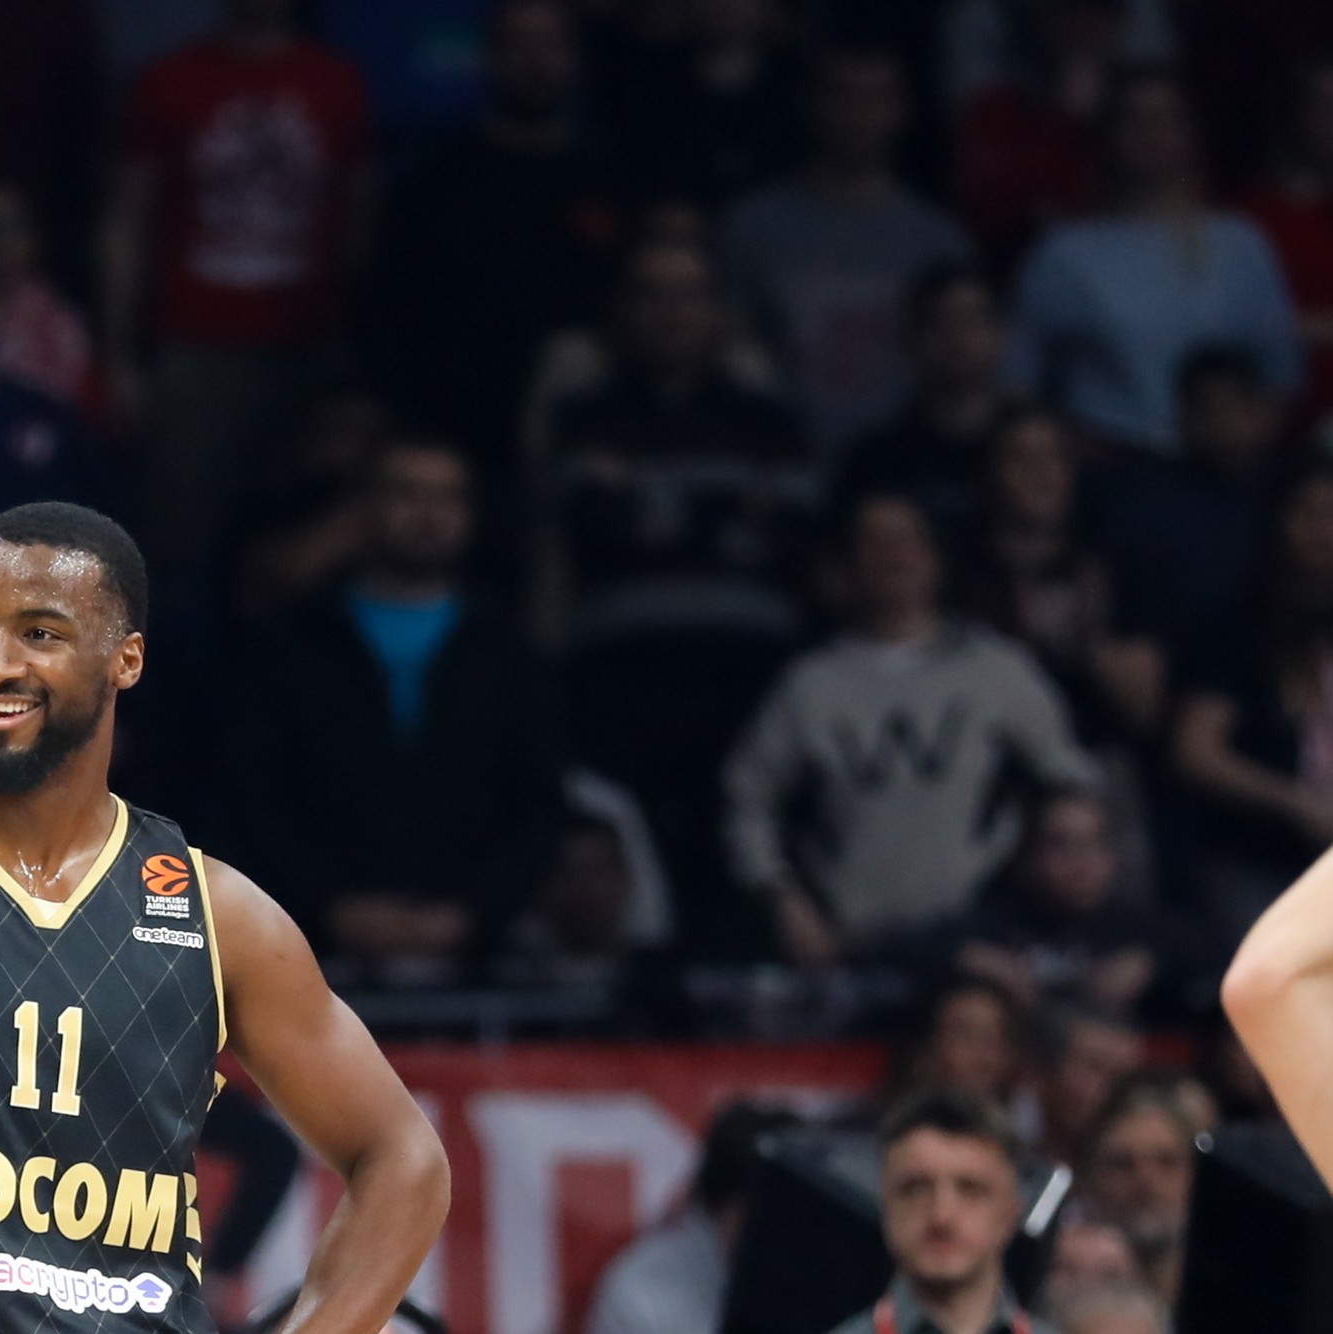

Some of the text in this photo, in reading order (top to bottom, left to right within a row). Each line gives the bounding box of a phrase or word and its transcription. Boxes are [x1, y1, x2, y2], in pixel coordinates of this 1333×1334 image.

[145, 895, 189, 904] TURKISH
[146, 903, 189, 912] AIRLINES
[10, 1001, 83, 1116] 11
